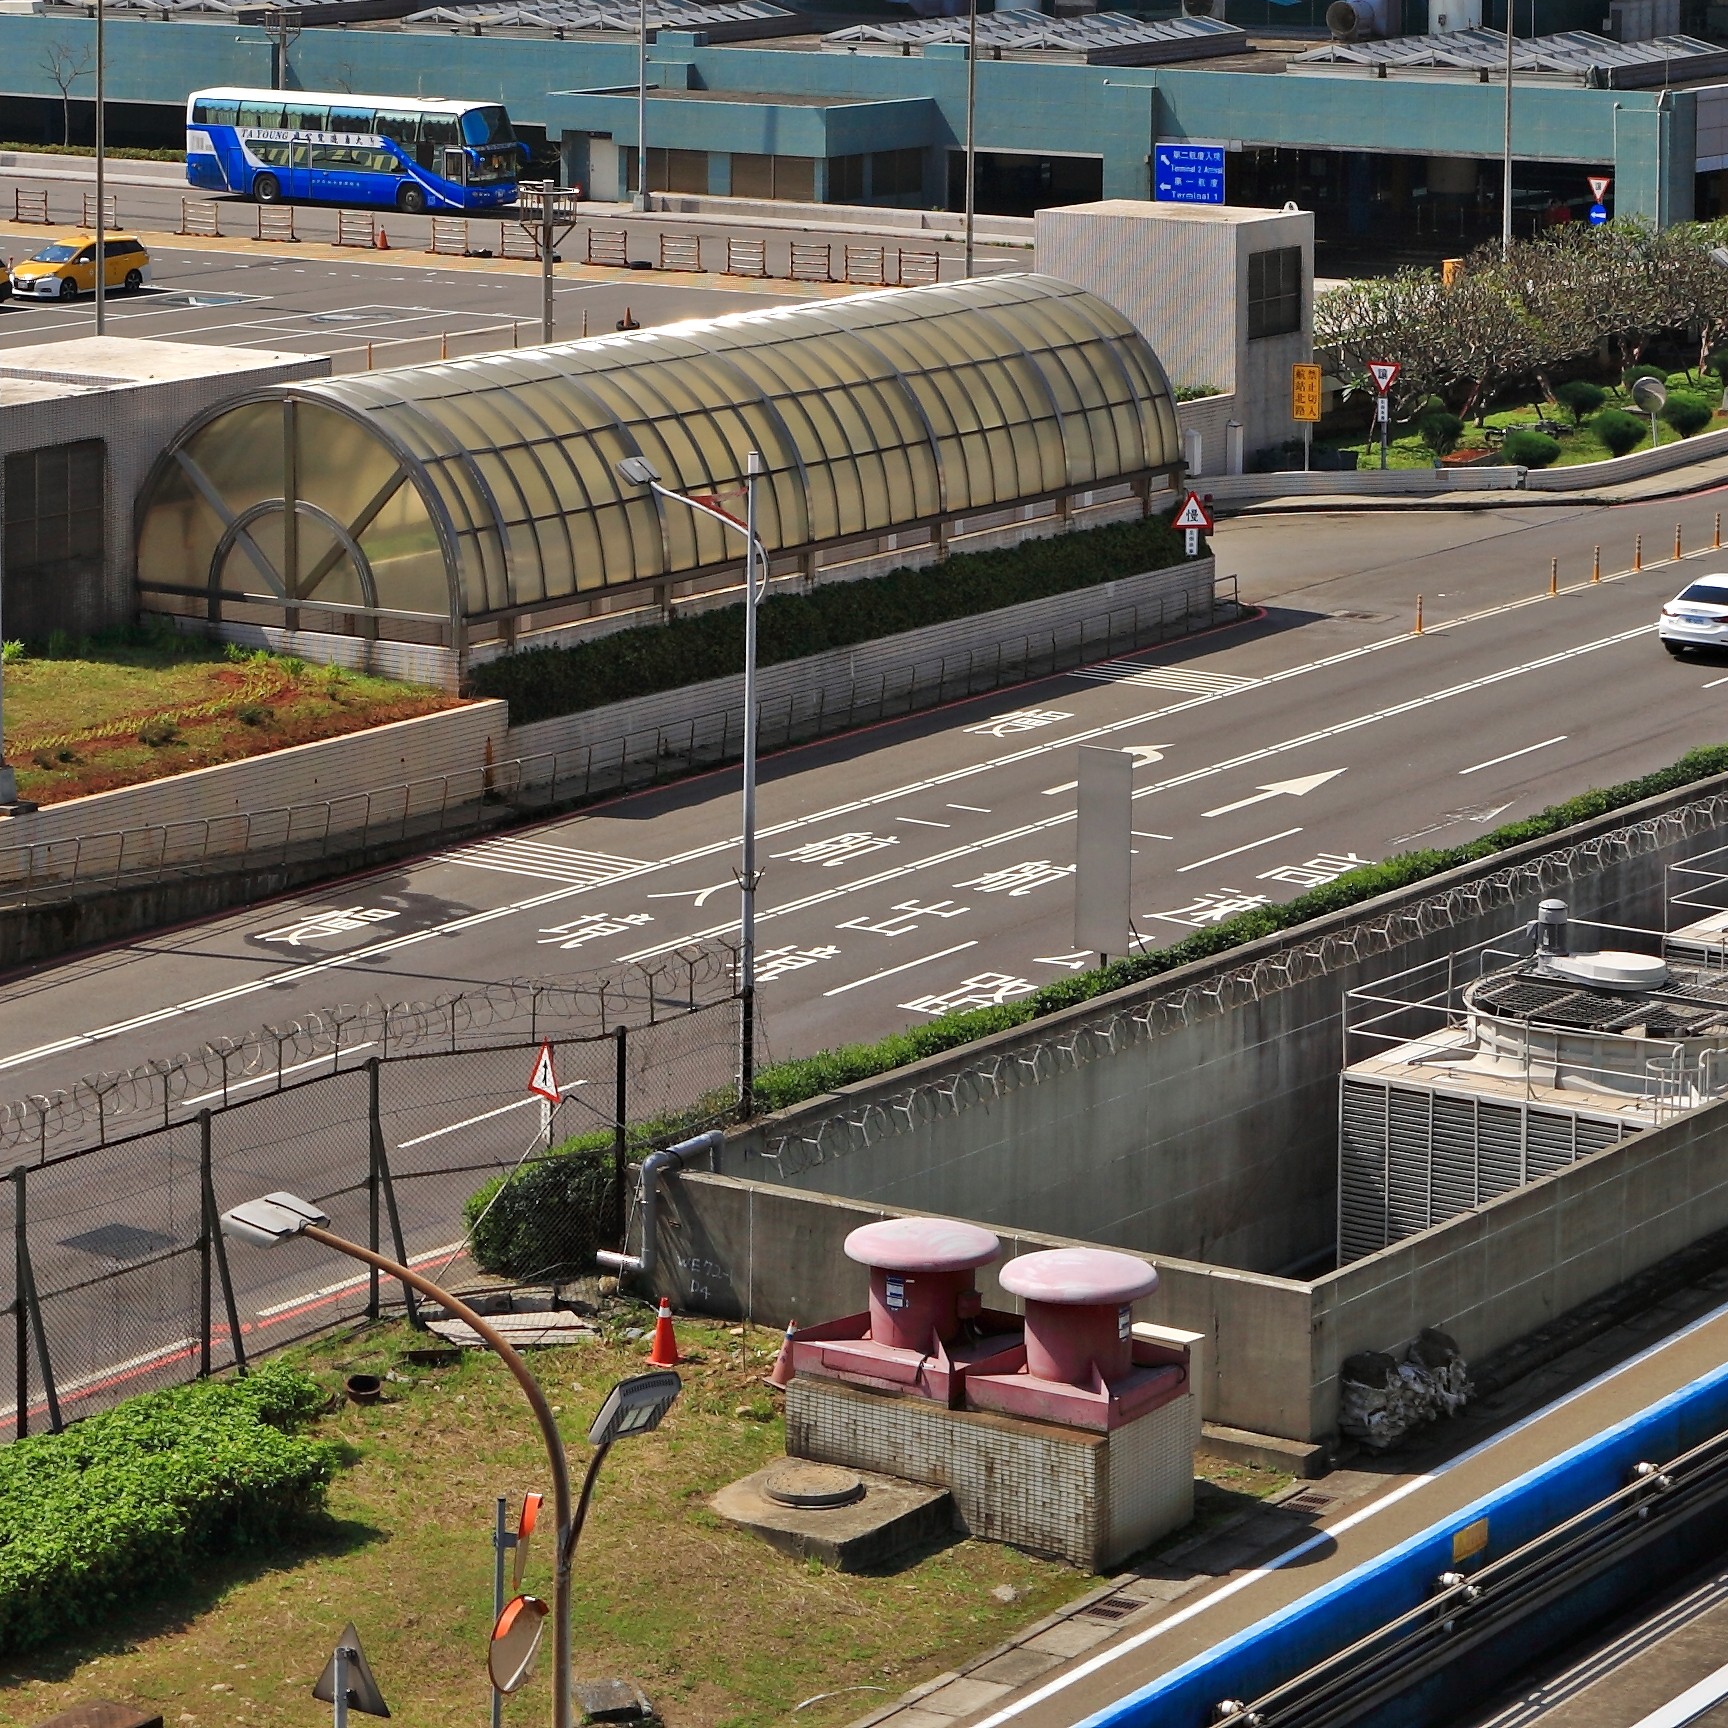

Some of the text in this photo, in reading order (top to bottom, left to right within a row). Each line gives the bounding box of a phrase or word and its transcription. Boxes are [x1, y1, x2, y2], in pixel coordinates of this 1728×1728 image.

[257, 129, 289, 139] YOUNG
[1172, 191, 1210, 200] Terminal
[1186, 508, 1199, 522] 慢
